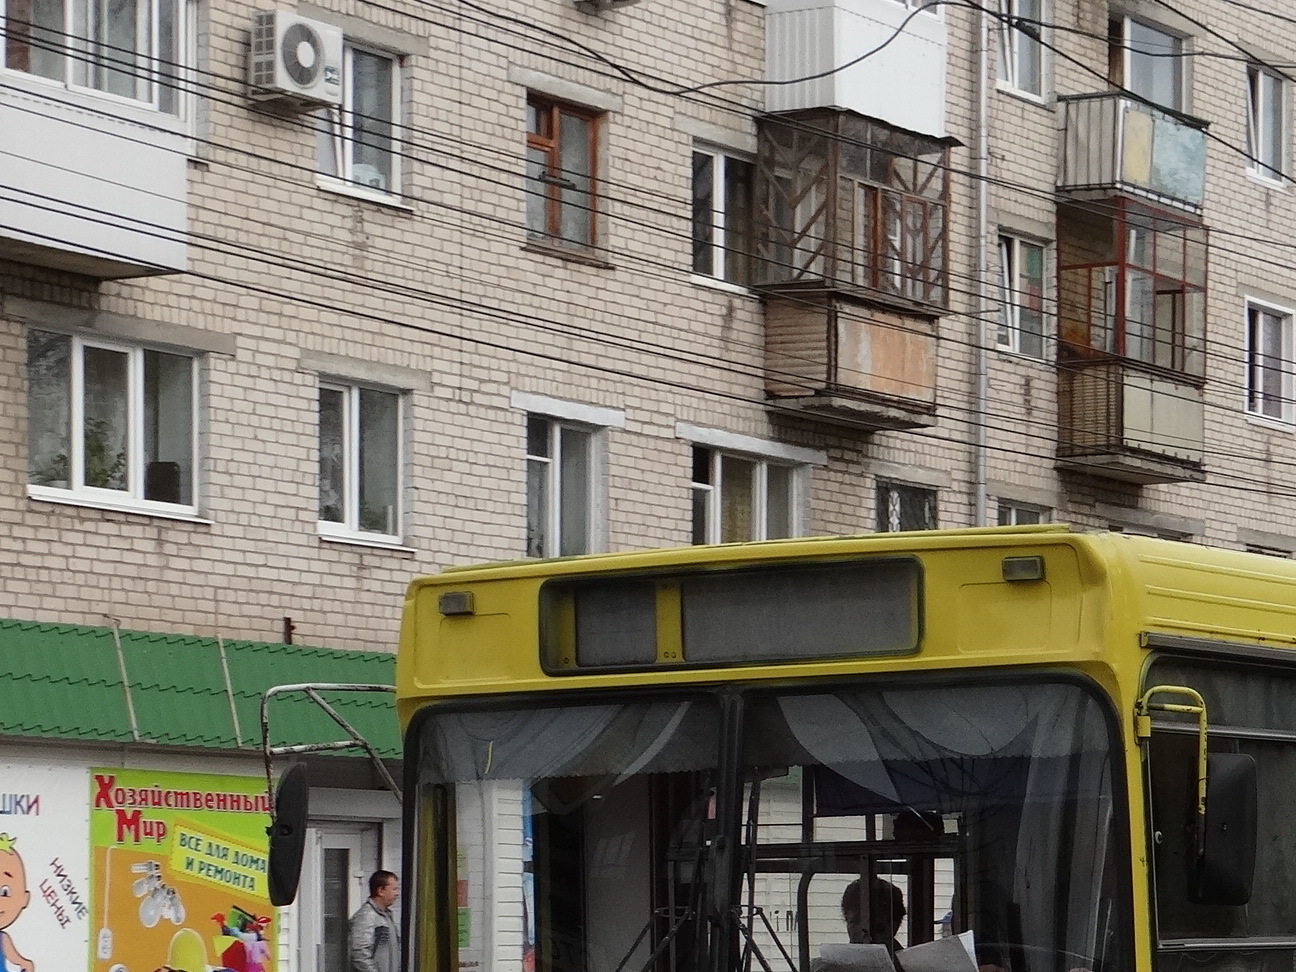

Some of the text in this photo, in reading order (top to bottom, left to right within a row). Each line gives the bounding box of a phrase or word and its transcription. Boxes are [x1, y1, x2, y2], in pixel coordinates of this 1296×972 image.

[116, 809, 167, 843] Мир
[185, 856, 255, 891] И РЕМОНТА
[205, 842, 229, 861] ДЛЯ
[232, 851, 267, 874] ДОМА
[39, 878, 71, 930] ЦЕНЫ
[49, 856, 89, 921] НИЗКИЕ
